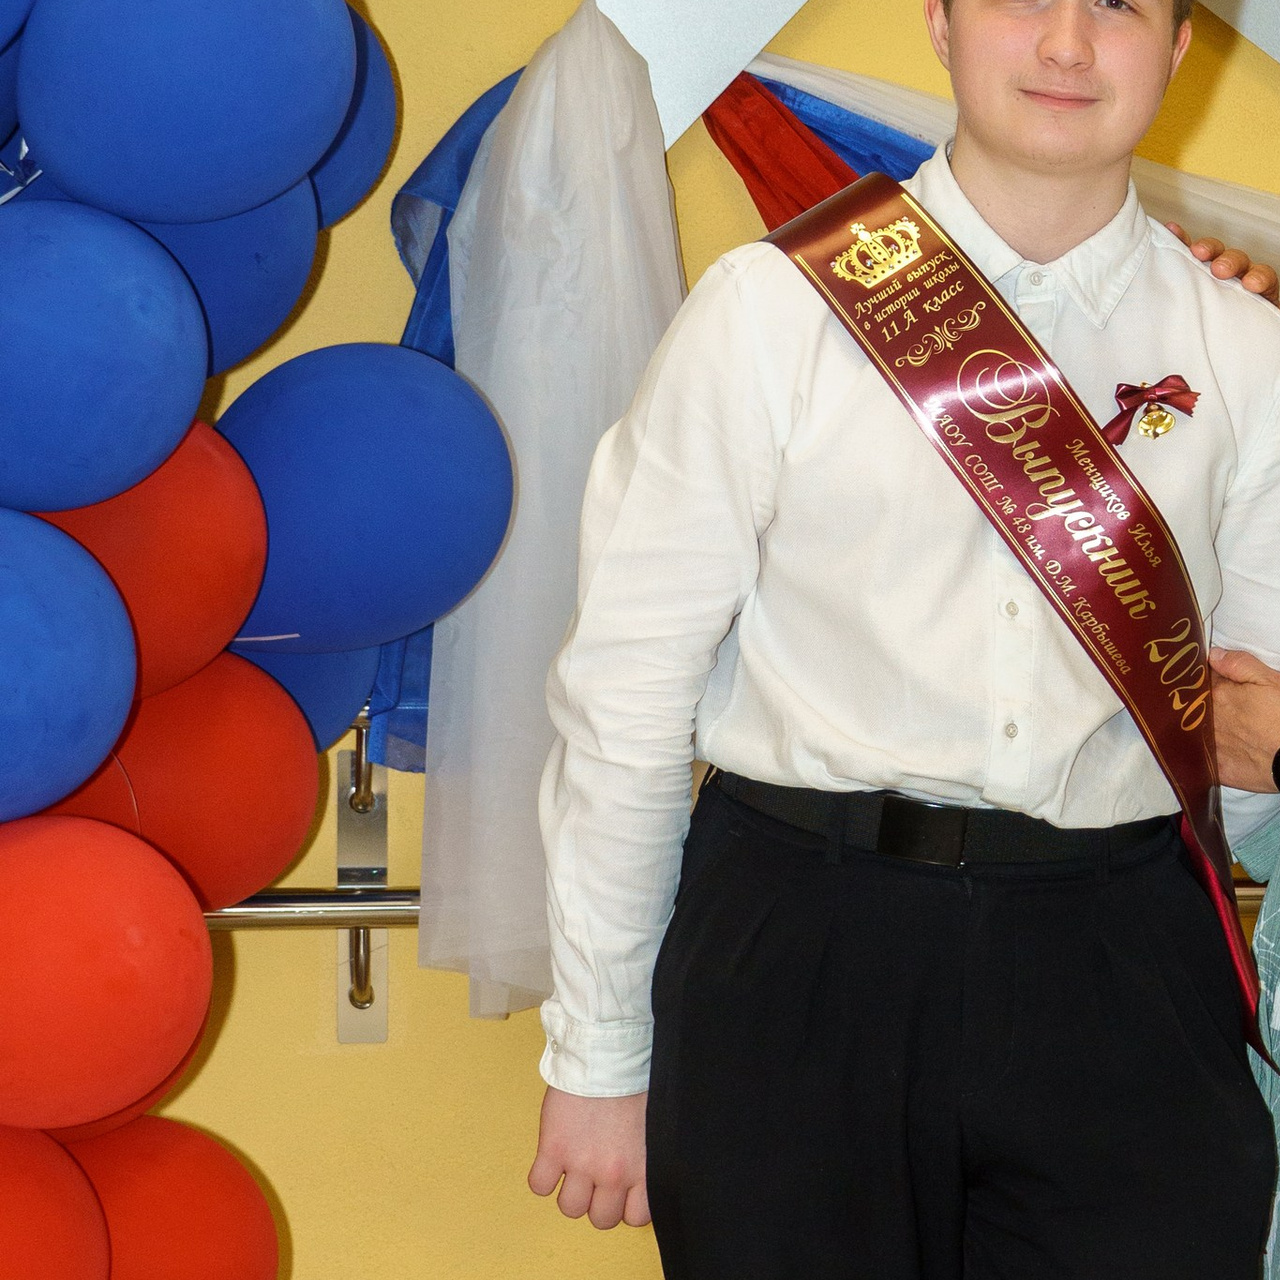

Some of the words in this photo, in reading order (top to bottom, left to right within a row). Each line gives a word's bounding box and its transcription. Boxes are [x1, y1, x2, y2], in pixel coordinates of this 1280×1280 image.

[854, 279, 903, 319] Лучший
[906, 251, 953, 282] выпуск
[863, 321, 871, 331] в
[874, 287, 921, 323] истории
[923, 262, 960, 289] школы
[881, 320, 901, 342] 11
[903, 309, 918, 331] А
[922, 280, 964, 313] класс
[957, 348, 1156, 621] Выпускник
[1143, 617, 1211, 732] 2026
[1065, 438, 1131, 520] Менщиков
[1127, 523, 1162, 568] Илья
[964, 454, 1004, 493] СОШ
[995, 495, 1017, 516] №
[1012, 517, 1032, 533] 48
[1072, 596, 1131, 675] Карбышева
